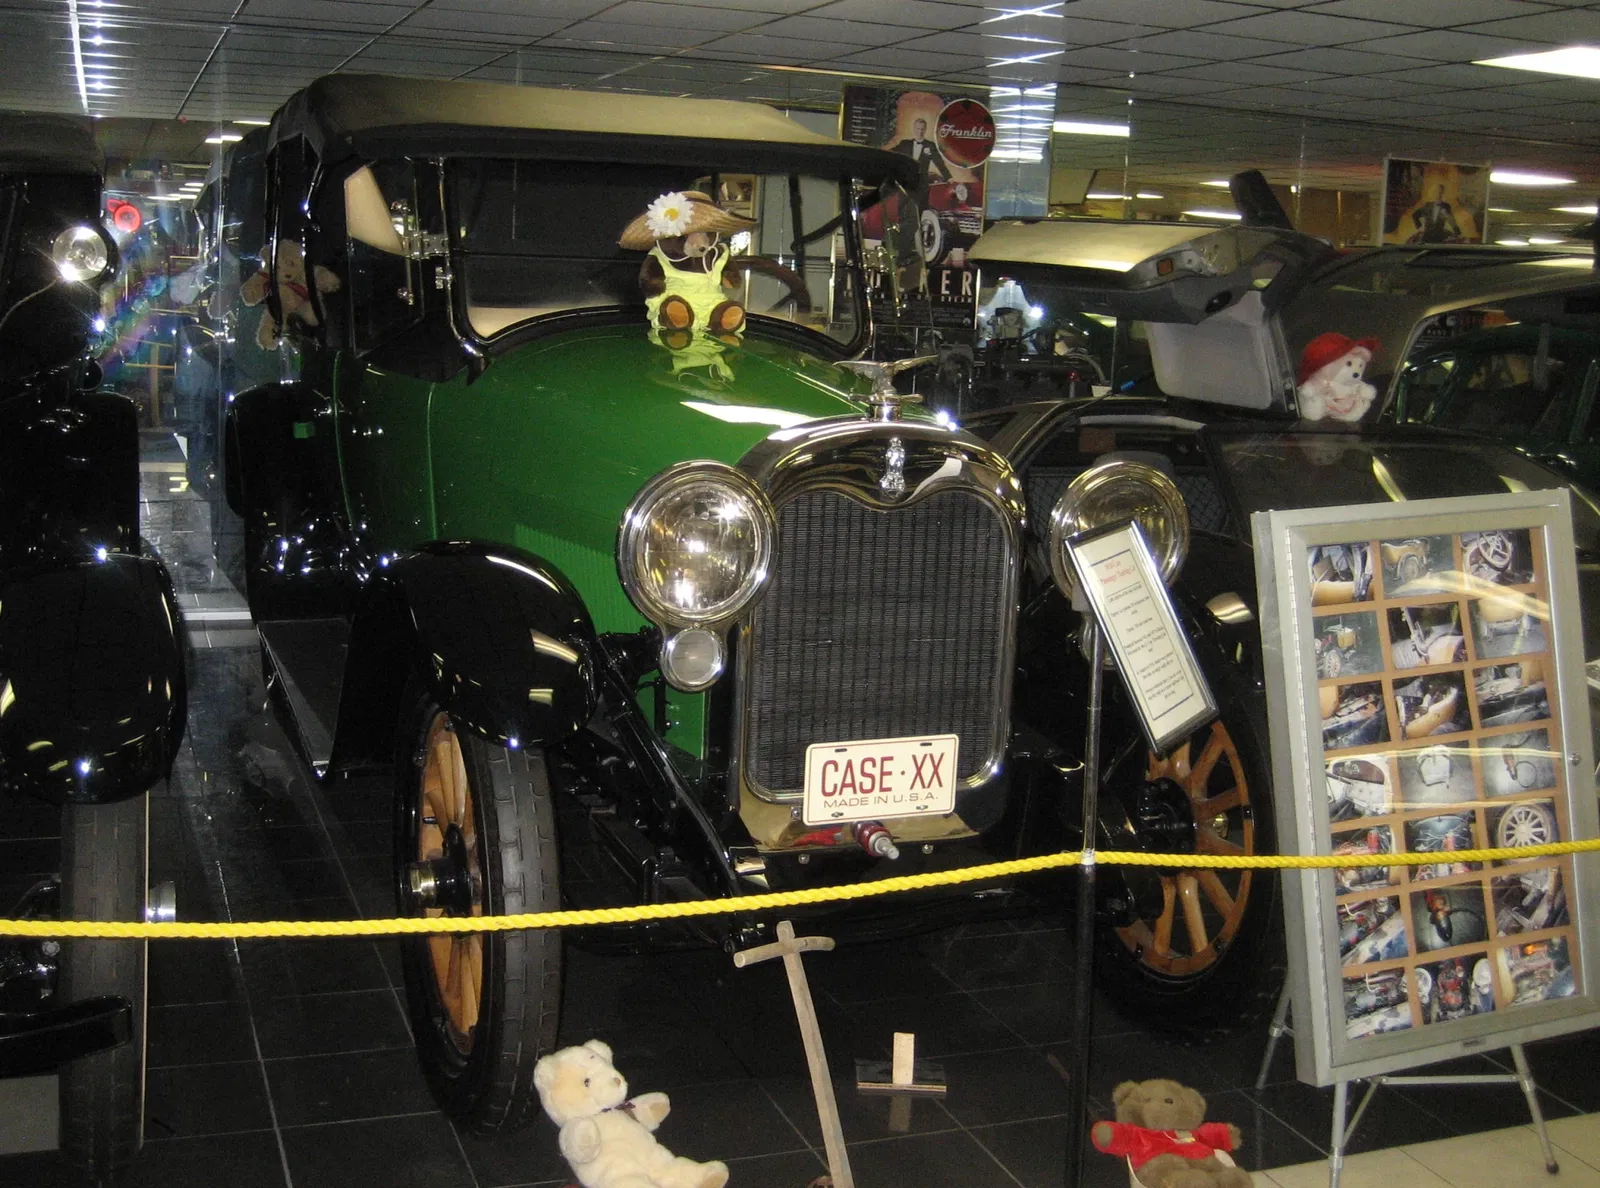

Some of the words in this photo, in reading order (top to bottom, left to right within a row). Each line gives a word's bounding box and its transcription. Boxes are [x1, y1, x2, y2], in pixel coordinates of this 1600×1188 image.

[940, 124, 991, 138] Franklin
[821, 756, 894, 797] CASE
[823, 796, 869, 808] MADE
[873, 795, 889, 804] IN
[893, 792, 939, 803] U.S.A.
